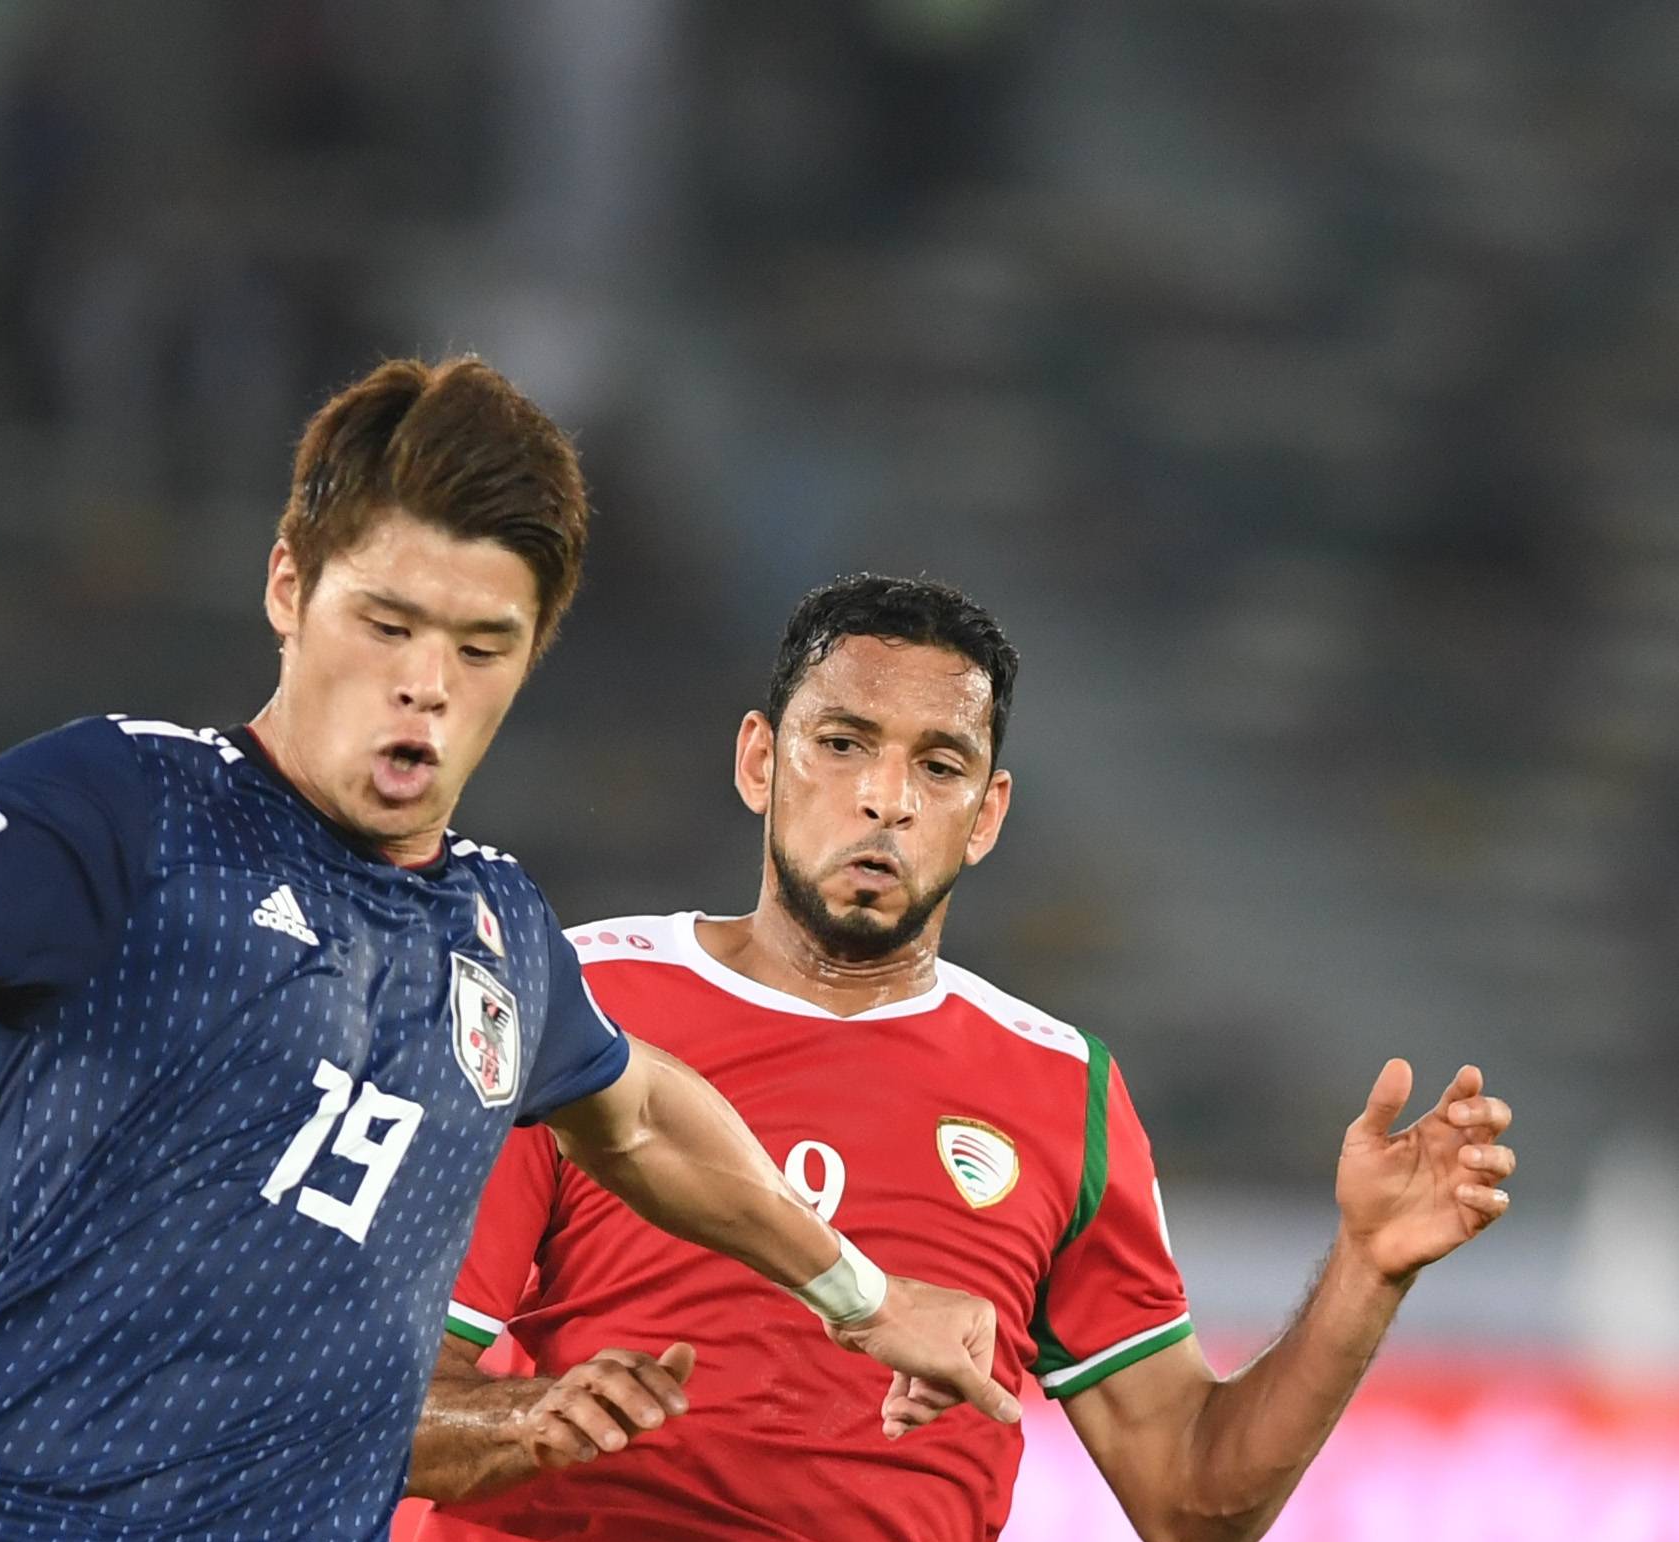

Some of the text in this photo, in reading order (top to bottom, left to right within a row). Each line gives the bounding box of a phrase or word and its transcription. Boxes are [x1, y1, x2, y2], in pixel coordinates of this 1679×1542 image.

[252, 908, 320, 946] adidas
[260, 1058, 424, 1244] 19
[784, 1140, 846, 1223] 9
